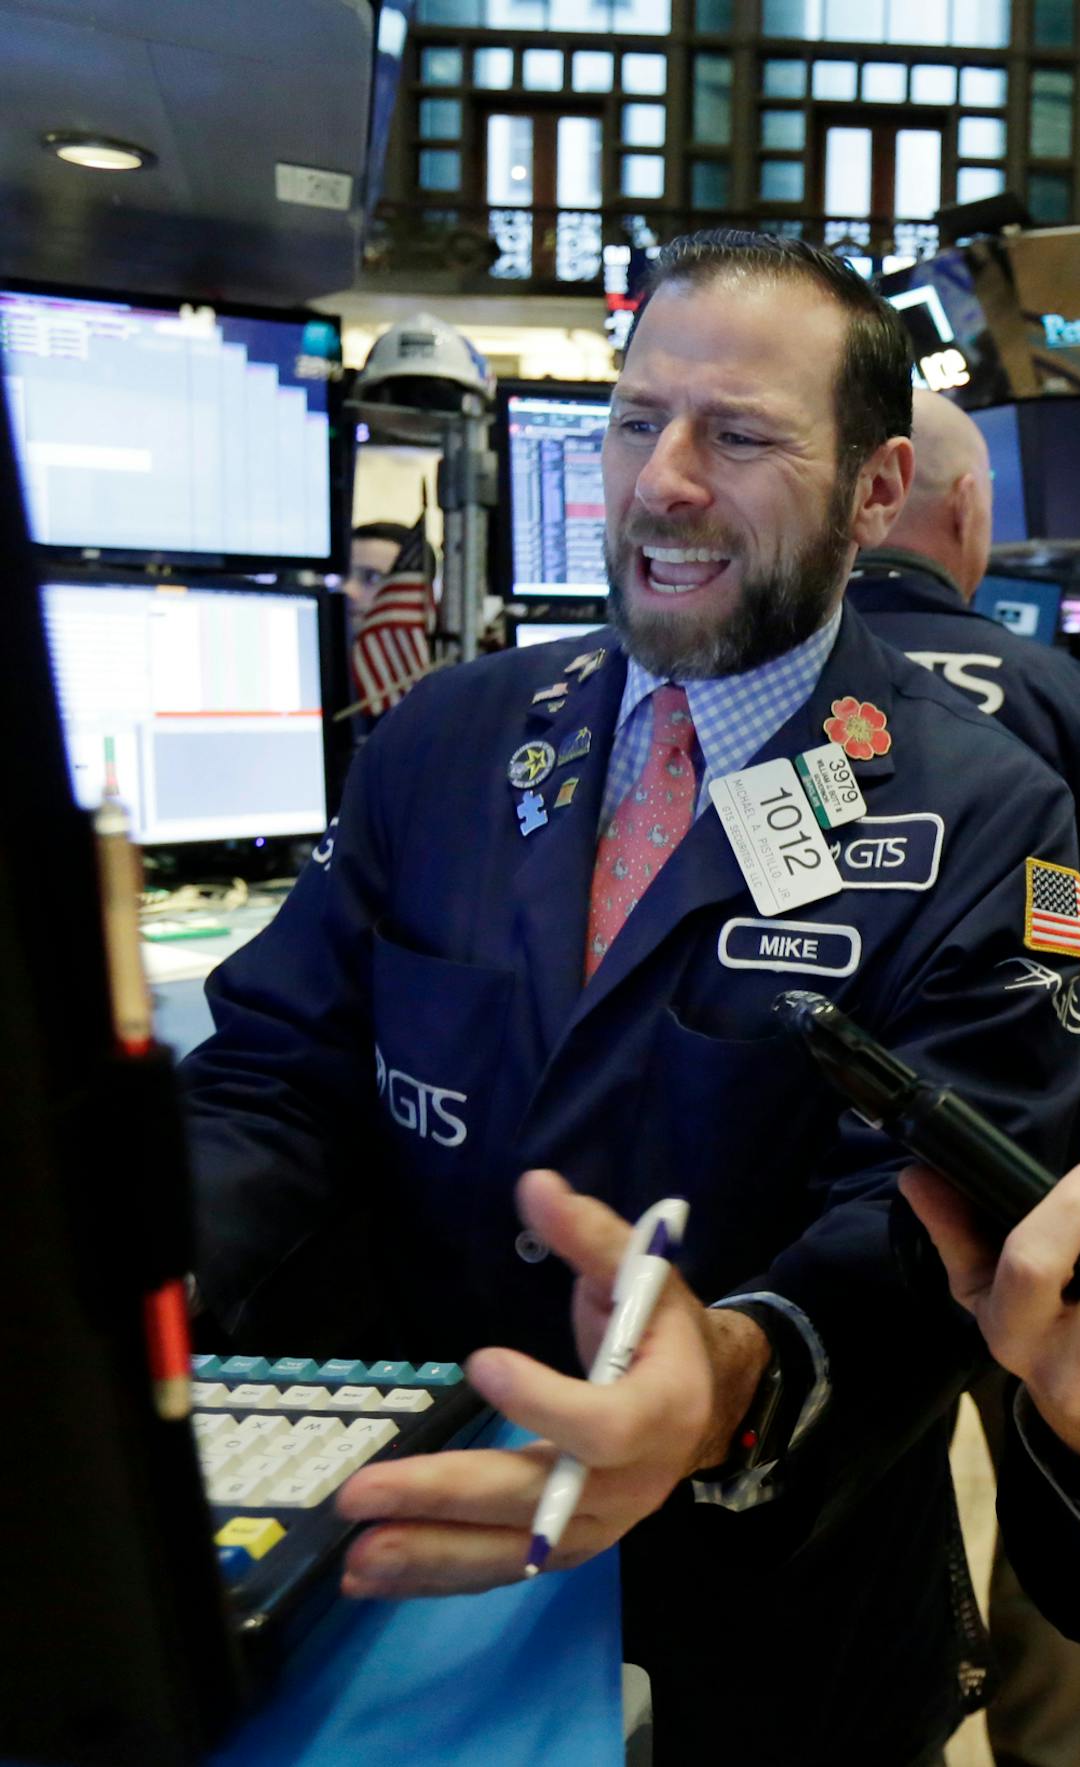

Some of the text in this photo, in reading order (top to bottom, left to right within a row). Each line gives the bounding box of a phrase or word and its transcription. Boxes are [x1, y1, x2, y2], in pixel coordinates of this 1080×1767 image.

[732, 779, 756, 820] MICHAEL
[829, 759, 858, 804] 3979
[760, 787, 821, 876] 1012
[844, 837, 906, 870] GTS
[759, 934, 819, 960] MIKE
[388, 1069, 468, 1147] GTS
